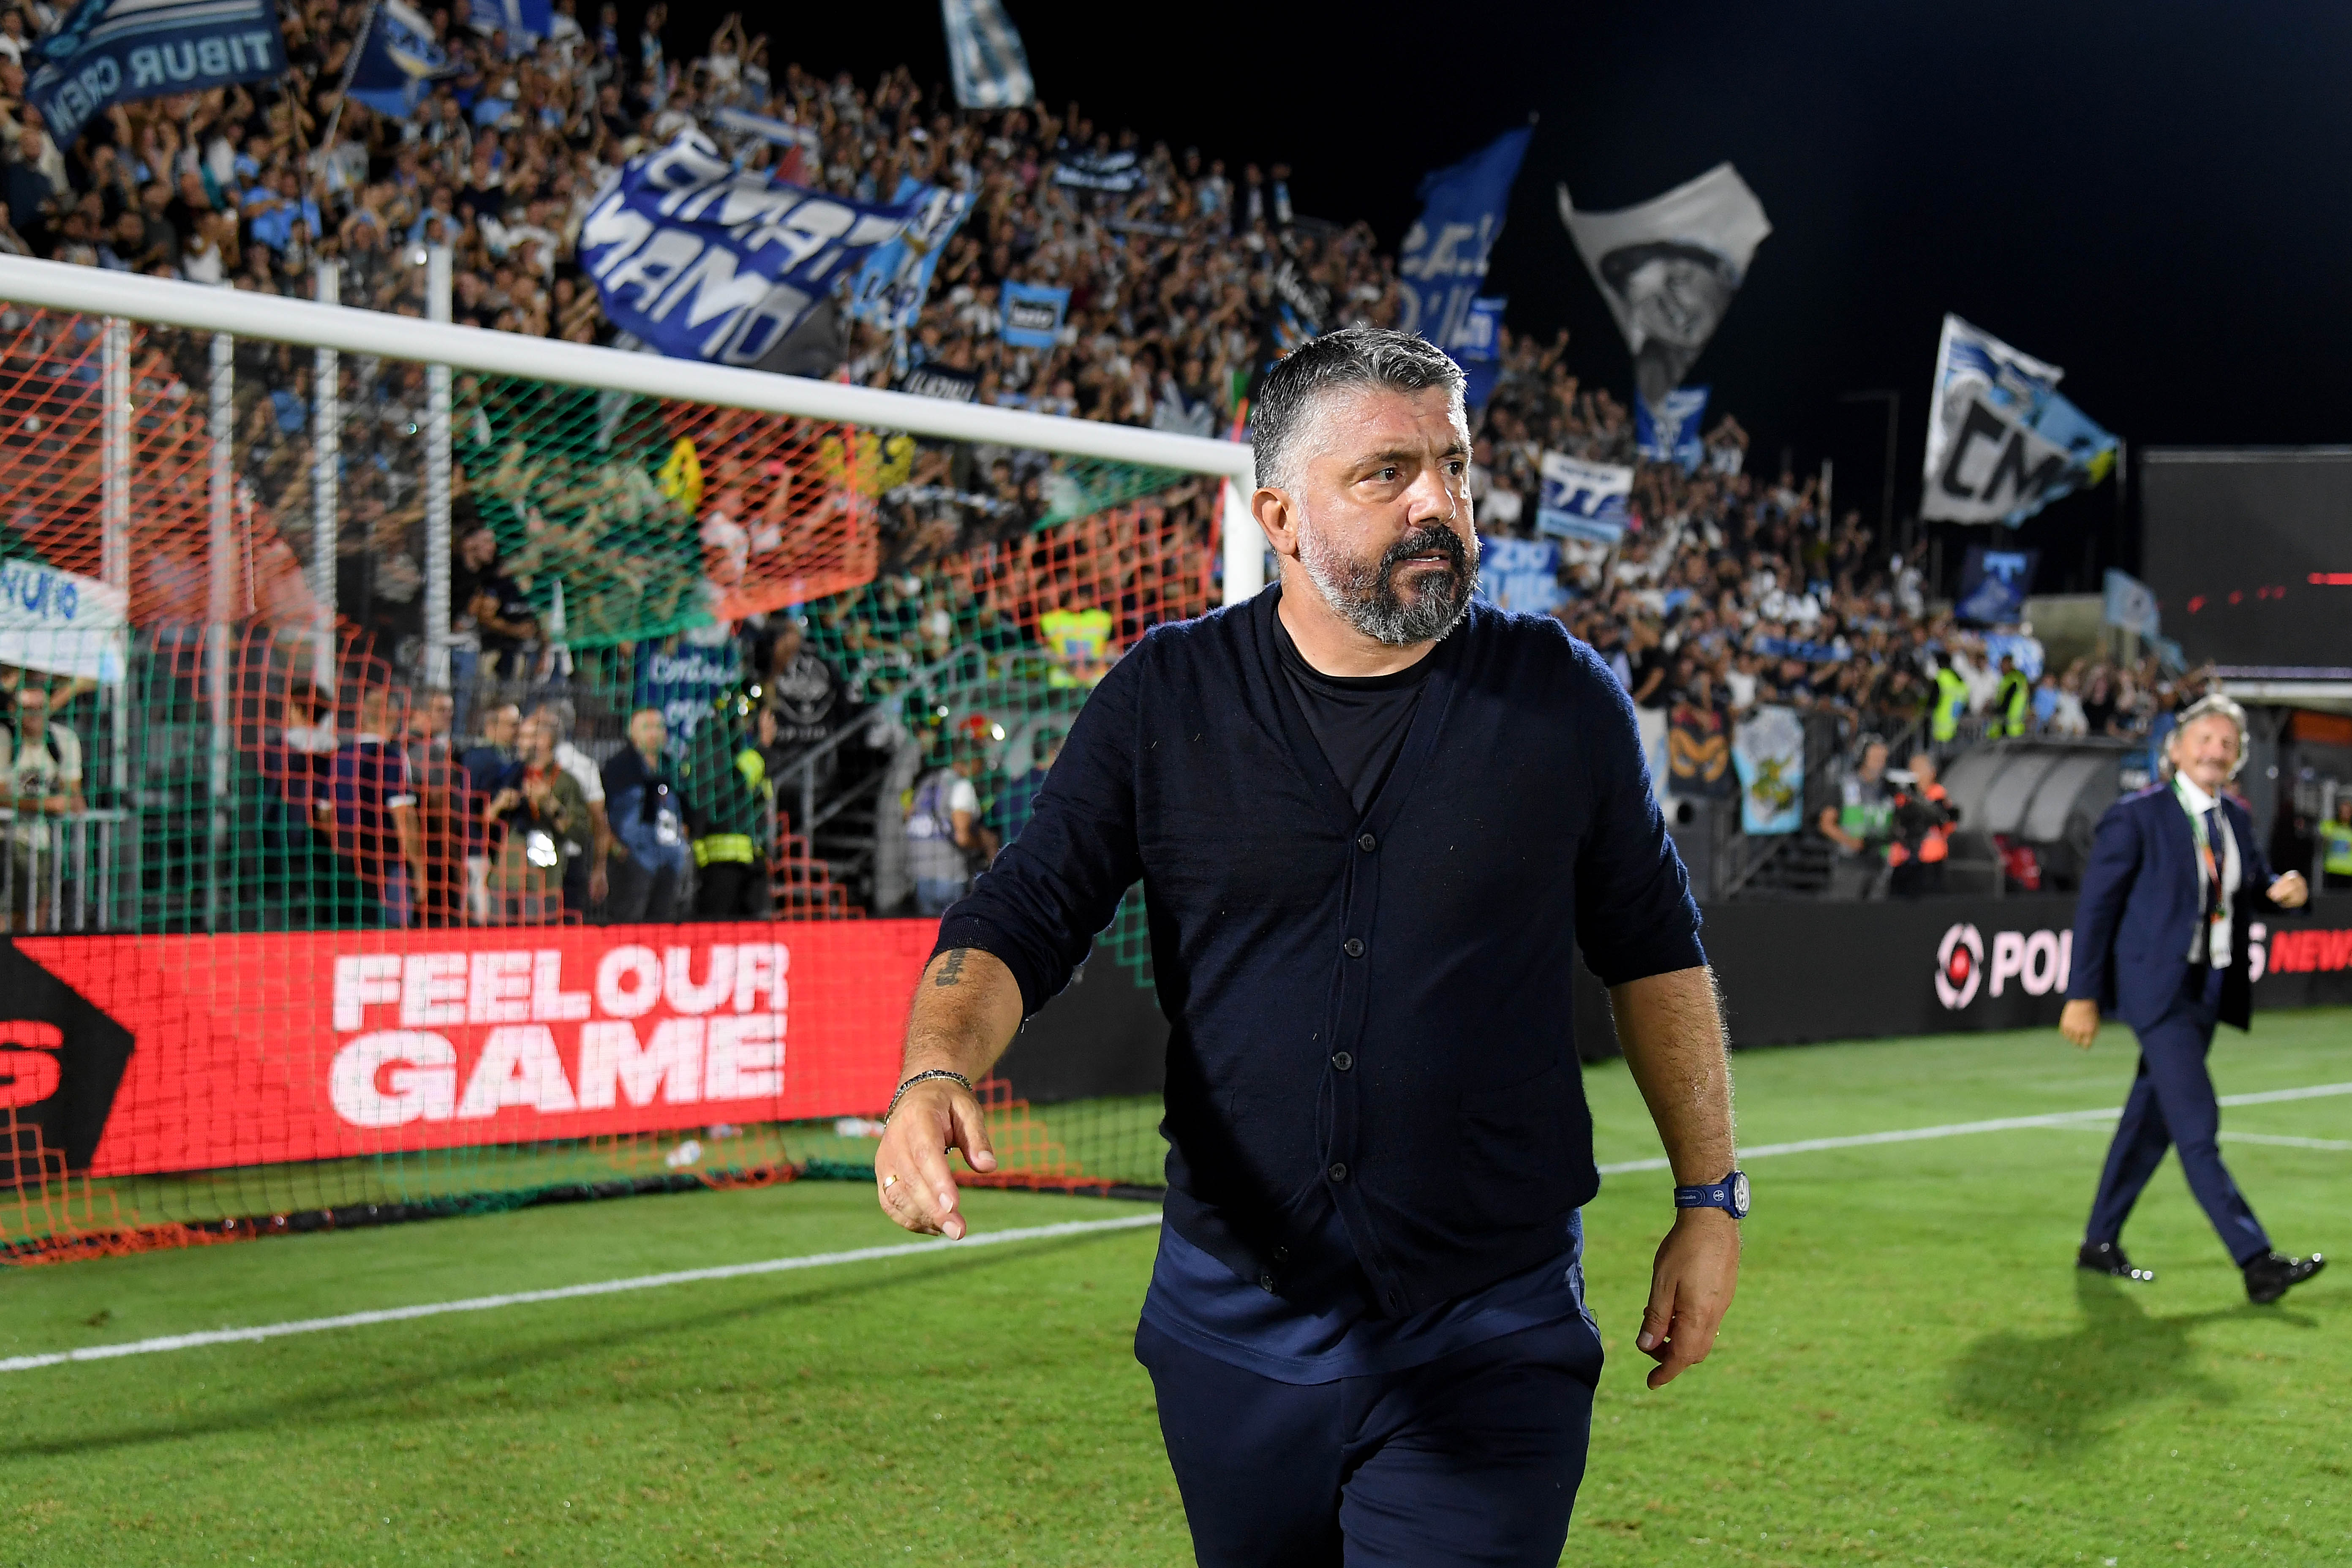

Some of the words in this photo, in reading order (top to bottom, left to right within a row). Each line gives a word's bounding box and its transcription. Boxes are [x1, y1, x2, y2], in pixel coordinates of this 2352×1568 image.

[333, 950, 592, 1032] FEEL
[596, 944, 790, 1019] OUR
[329, 1015, 787, 1129] GAME
